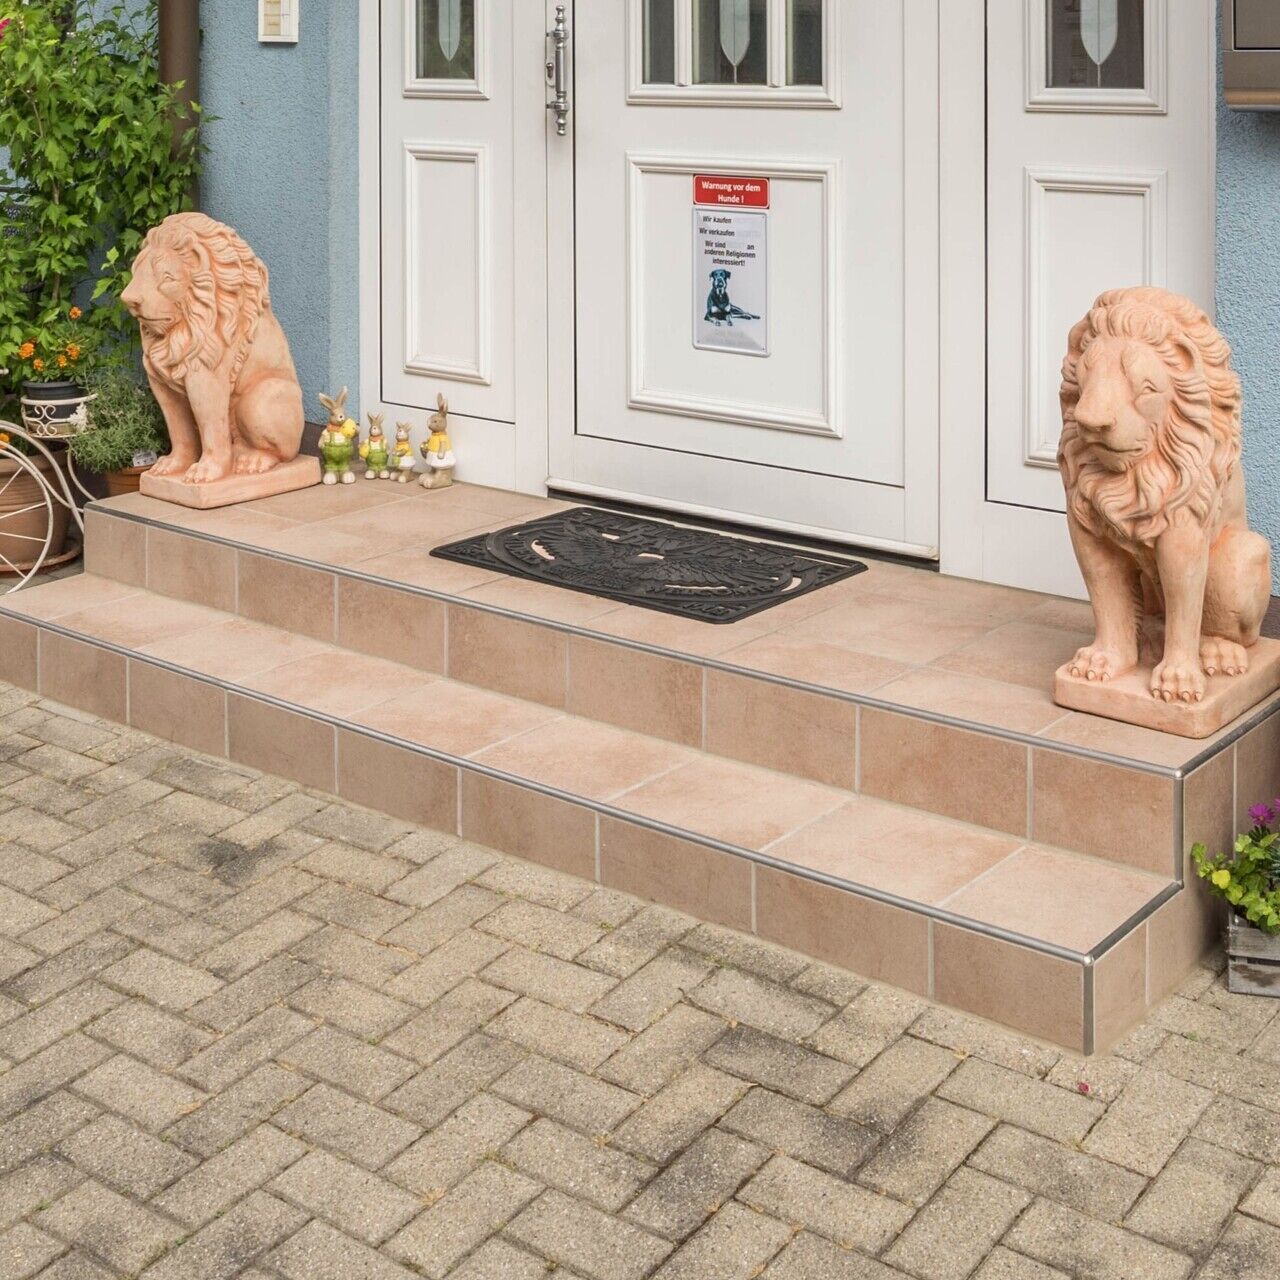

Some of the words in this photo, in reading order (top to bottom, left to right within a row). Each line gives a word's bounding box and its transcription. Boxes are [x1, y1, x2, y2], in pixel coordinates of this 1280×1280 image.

[701, 180, 732, 192] Warnung
[745, 183, 761, 192] dem
[717, 194, 740, 203] Hunde
[708, 229, 735, 237] verkaufen
[714, 241, 726, 249] sind
[704, 248, 725, 256] anderen
[725, 250, 756, 259] Religionen
